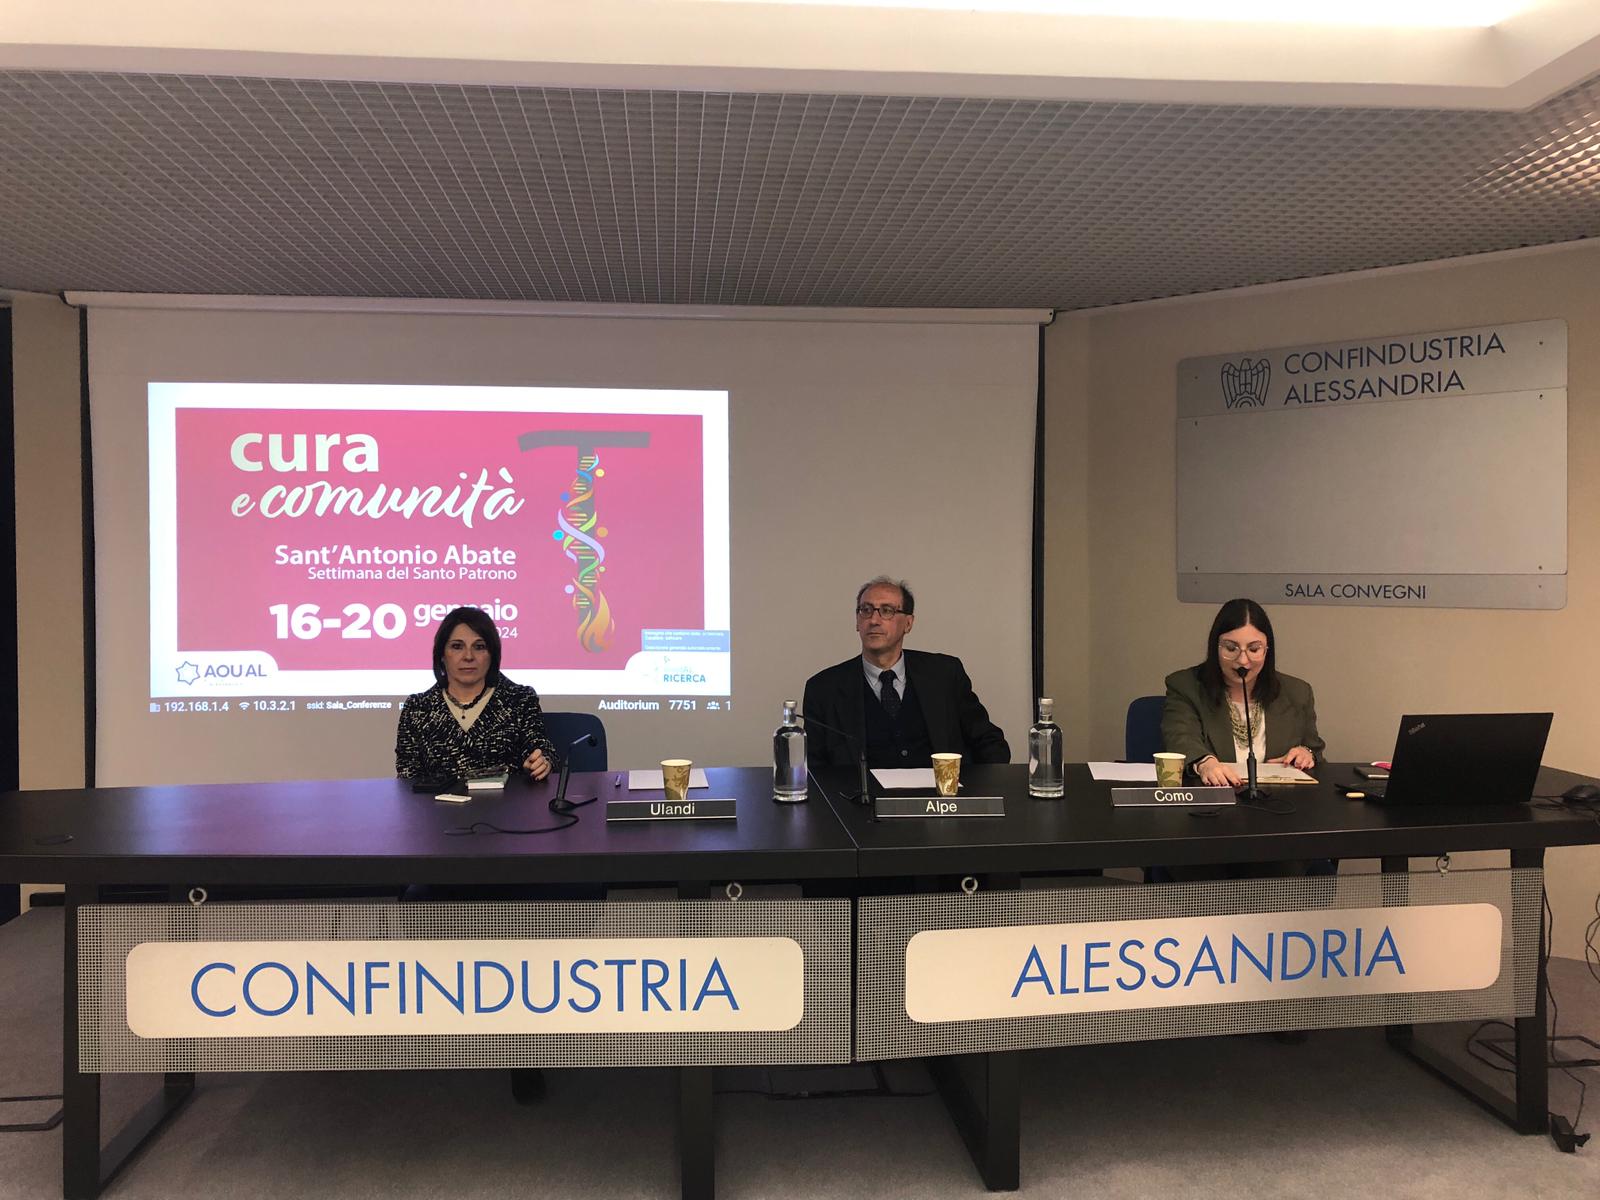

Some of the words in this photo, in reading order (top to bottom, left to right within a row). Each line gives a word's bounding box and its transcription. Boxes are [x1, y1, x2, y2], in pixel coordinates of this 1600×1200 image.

[1284, 332, 1506, 375] CONFINDUSTRIA
[1284, 370, 1465, 405] ALESSANDRIA
[230, 432, 379, 473] cura
[231, 493, 255, 517] e
[259, 467, 525, 528] comunità
[274, 544, 438, 565] Sant'Antonio
[444, 544, 517, 565] Abate
[308, 567, 383, 580] Settimana
[386, 567, 409, 580] del
[413, 567, 456, 580] Santo
[459, 567, 517, 580] Patrono
[1285, 583, 1325, 598] SALA
[1330, 584, 1427, 600] CONVEGNI
[269, 603, 407, 640] 16-20
[413, 598, 518, 627] geaio
[663, 674, 706, 683] RICERCA
[164, 702, 229, 712] 192.168.1.4
[253, 700, 296, 711] 10.3.2.1
[326, 700, 392, 710] Sala_Conferenze
[598, 699, 660, 710] Auditorium
[668, 700, 697, 710] 7751
[725, 701, 731, 711] 1
[925, 799, 958, 815] Alpe
[1154, 790, 1194, 803] Como
[650, 803, 696, 816] Ulandi
[1011, 925, 1406, 998] ALESSANDRIA
[190, 957, 740, 1018] CONFINDUSTRIA
